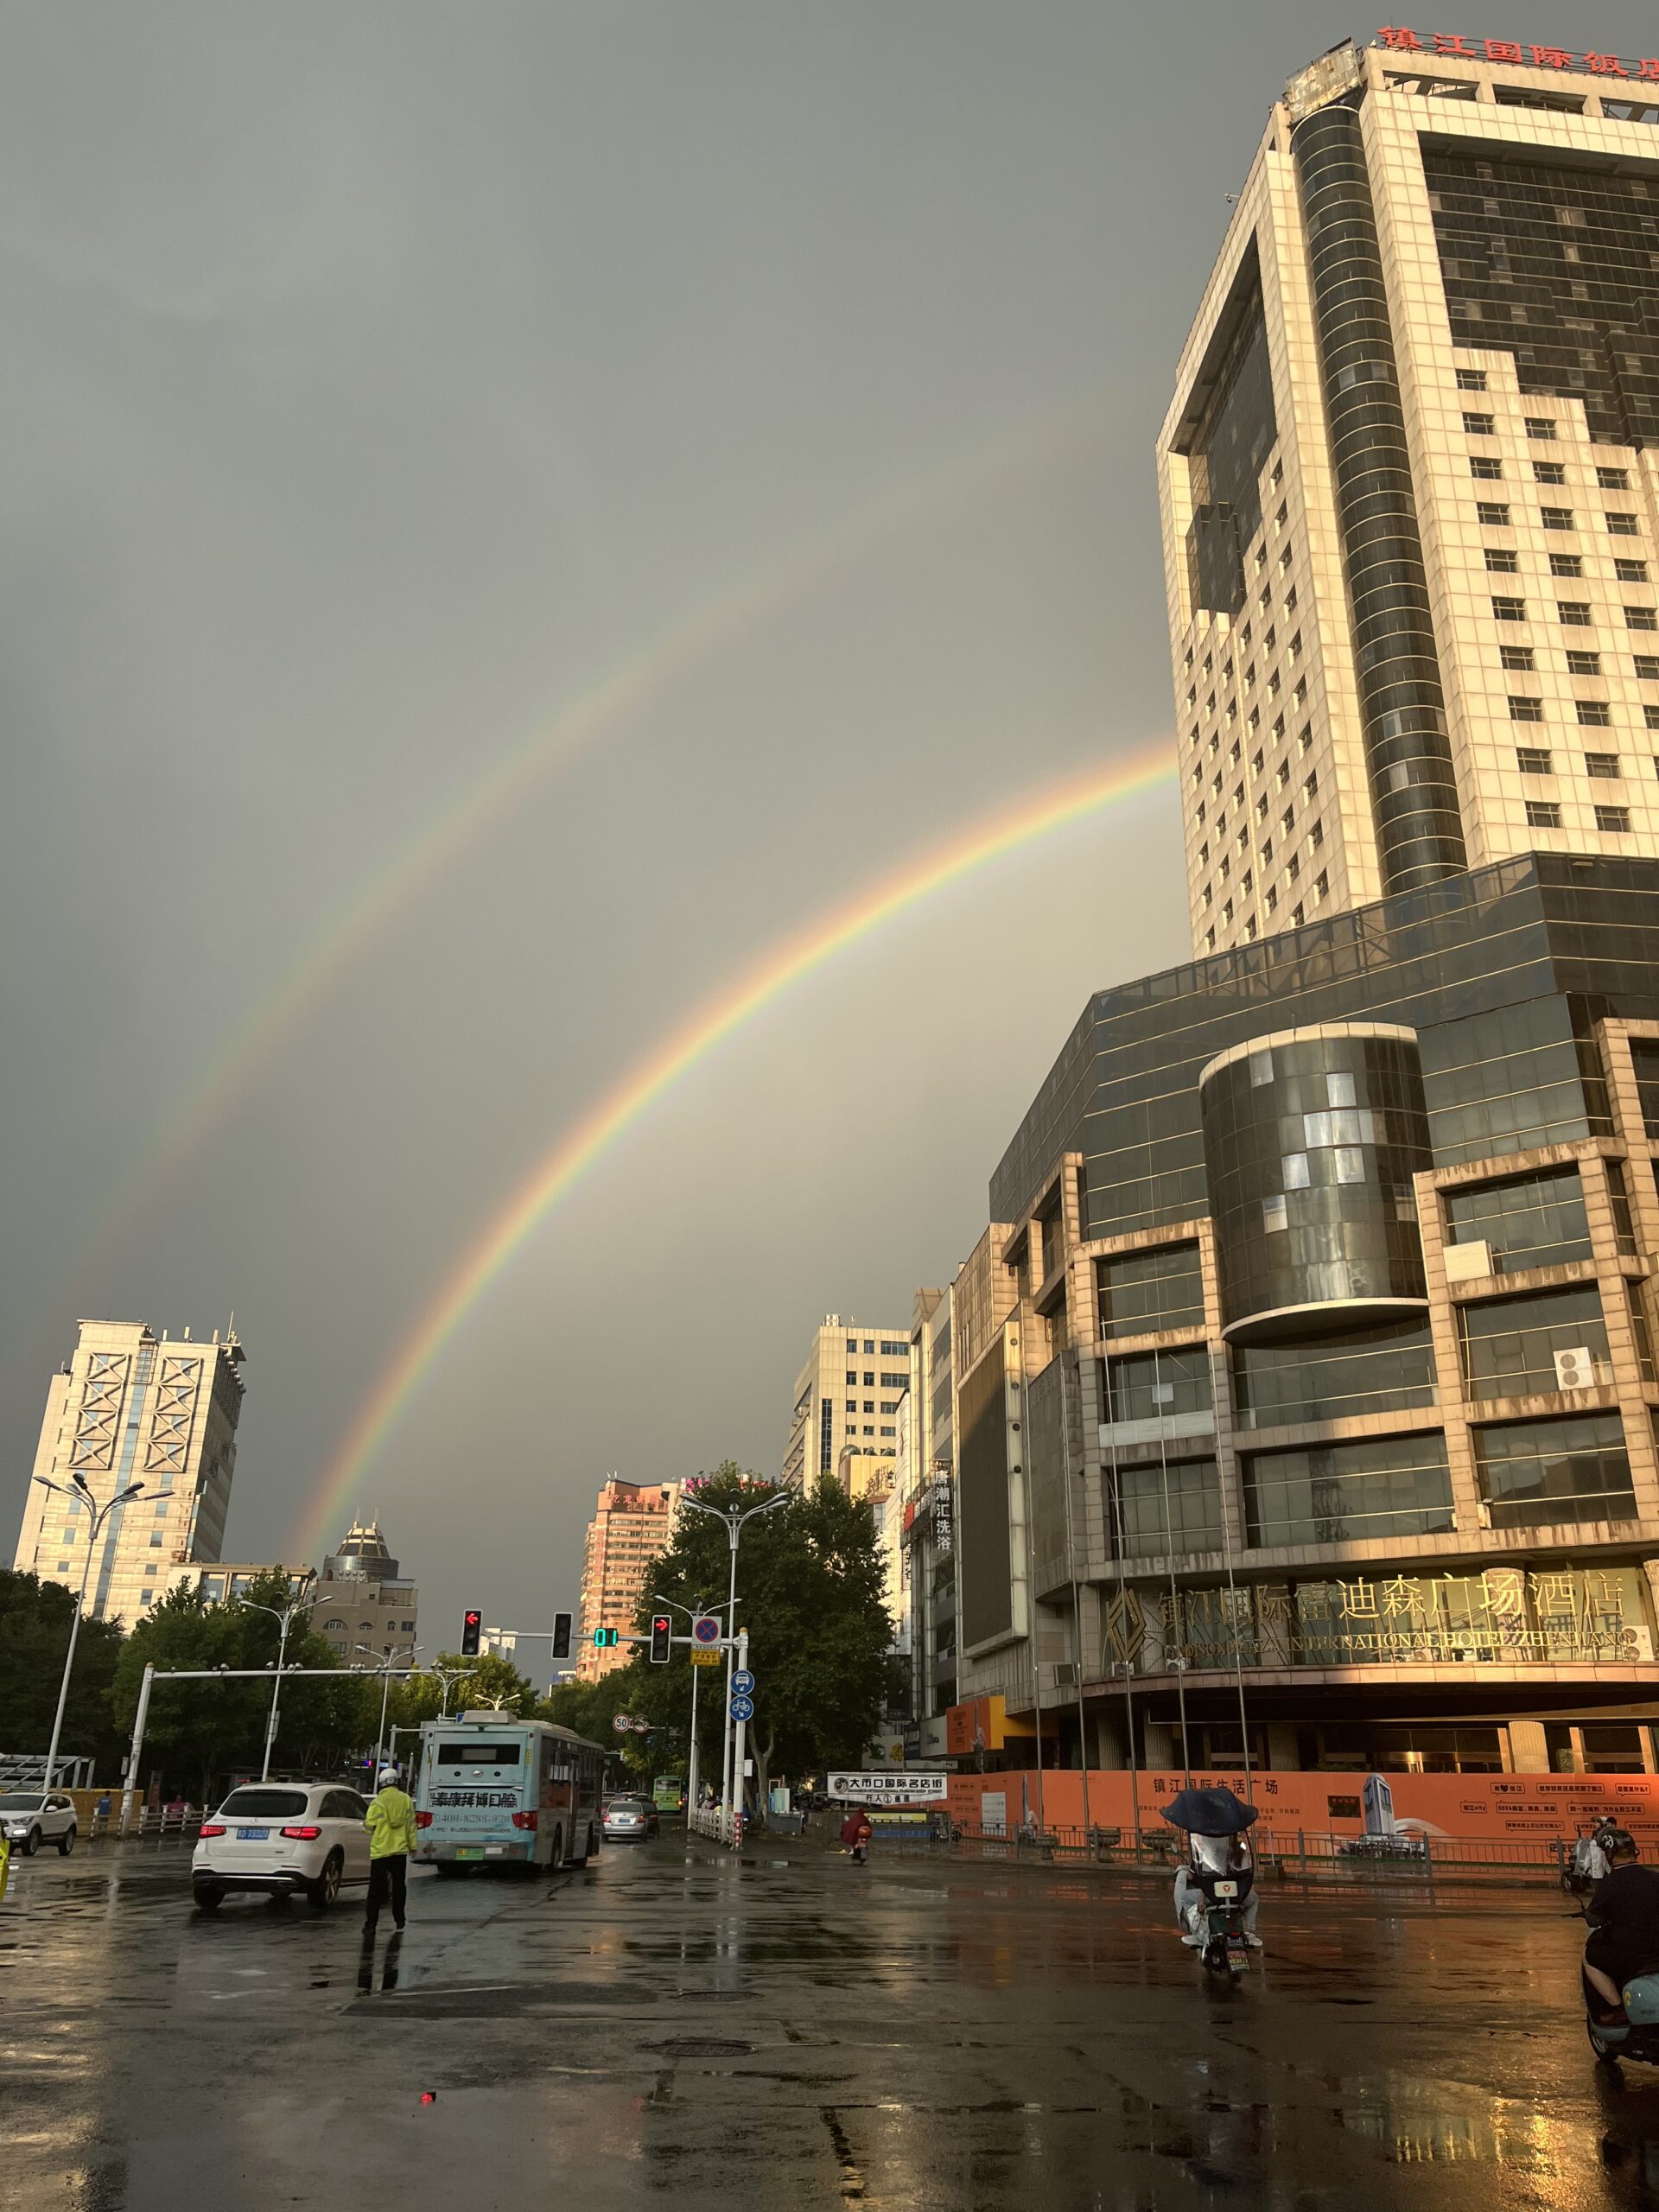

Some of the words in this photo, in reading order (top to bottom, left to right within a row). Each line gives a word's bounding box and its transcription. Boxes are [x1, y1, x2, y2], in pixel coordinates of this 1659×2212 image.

[1376, 25, 1659, 80] 镇江国际饭店
[935, 1470, 951, 1551] 唐潮汇洗浴
[1159, 1572, 1624, 1629] 镇江国际雷迪森广场酒店
[594, 1629, 617, 1646] 01
[1286, 1631, 1440, 1651] INTERNATIONAL
[1443, 1630, 1506, 1647] HOTEL
[1518, 1630, 1631, 1647] ZHENJIANG
[616, 1719, 626, 1727] 50
[849, 1778, 943, 1788] 大市口国际名店街
[435, 1791, 517, 1808] 泰康拜博口腔
